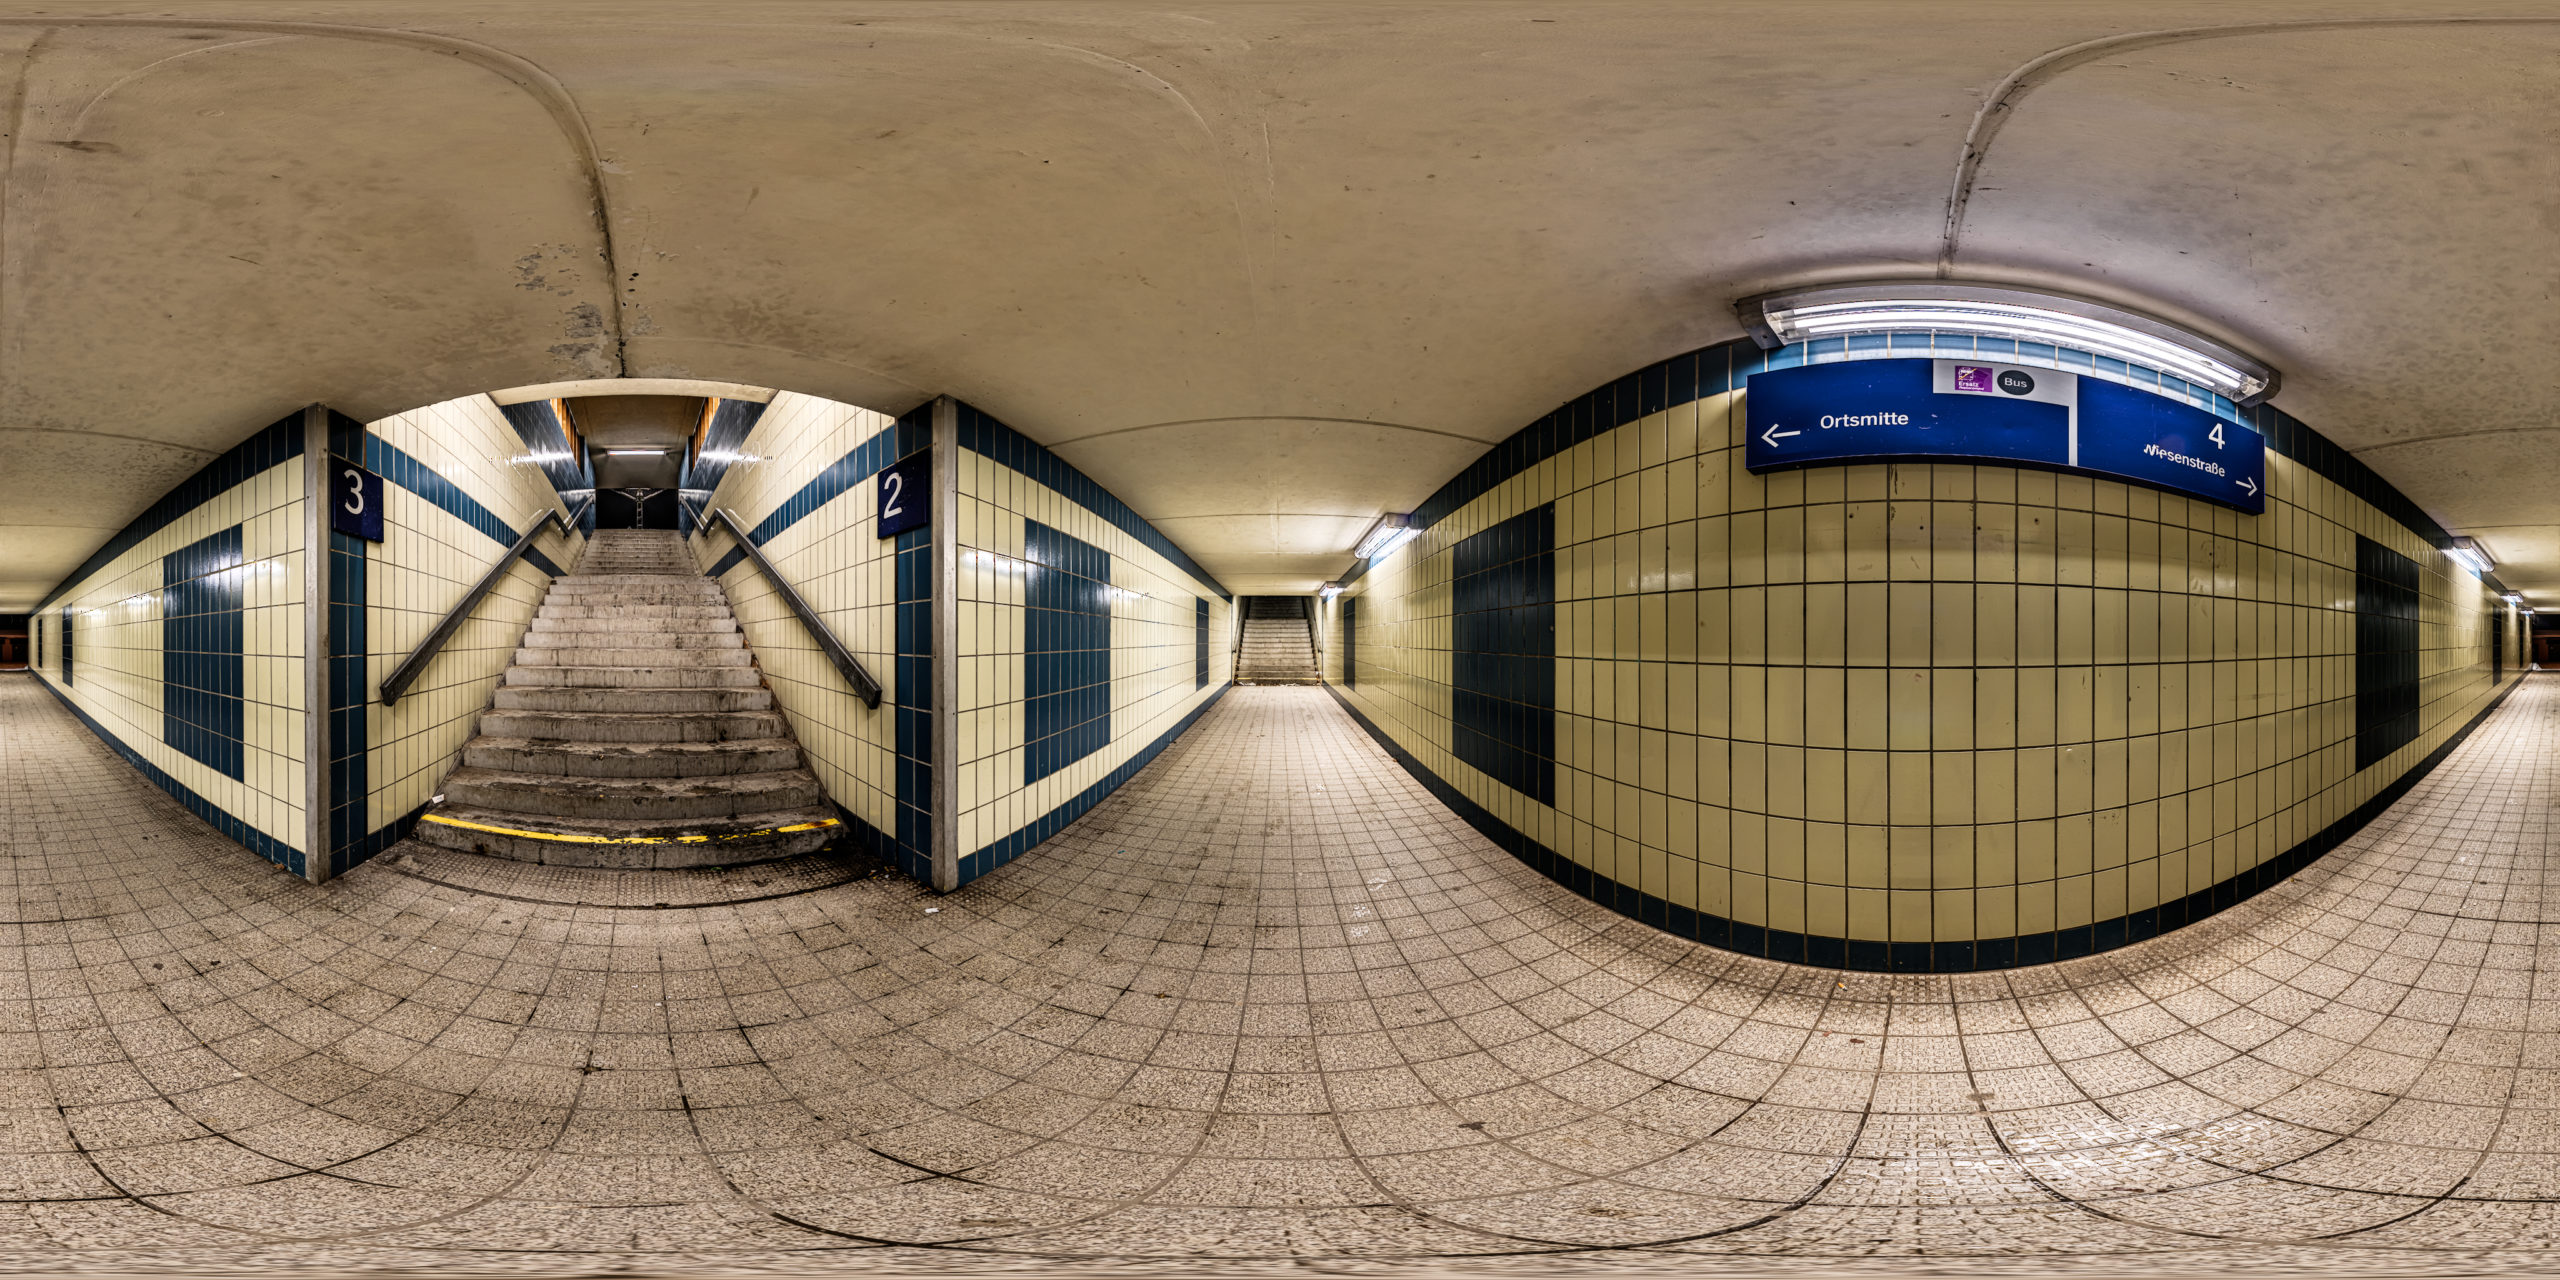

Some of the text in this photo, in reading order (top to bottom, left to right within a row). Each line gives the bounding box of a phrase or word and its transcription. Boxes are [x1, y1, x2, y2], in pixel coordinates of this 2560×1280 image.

[2004, 377, 2028, 388] Bus
[1820, 412, 1909, 429] Ortsmitte
[2208, 423, 2225, 450] 4
[343, 469, 364, 515] 3
[883, 472, 903, 519] 2
